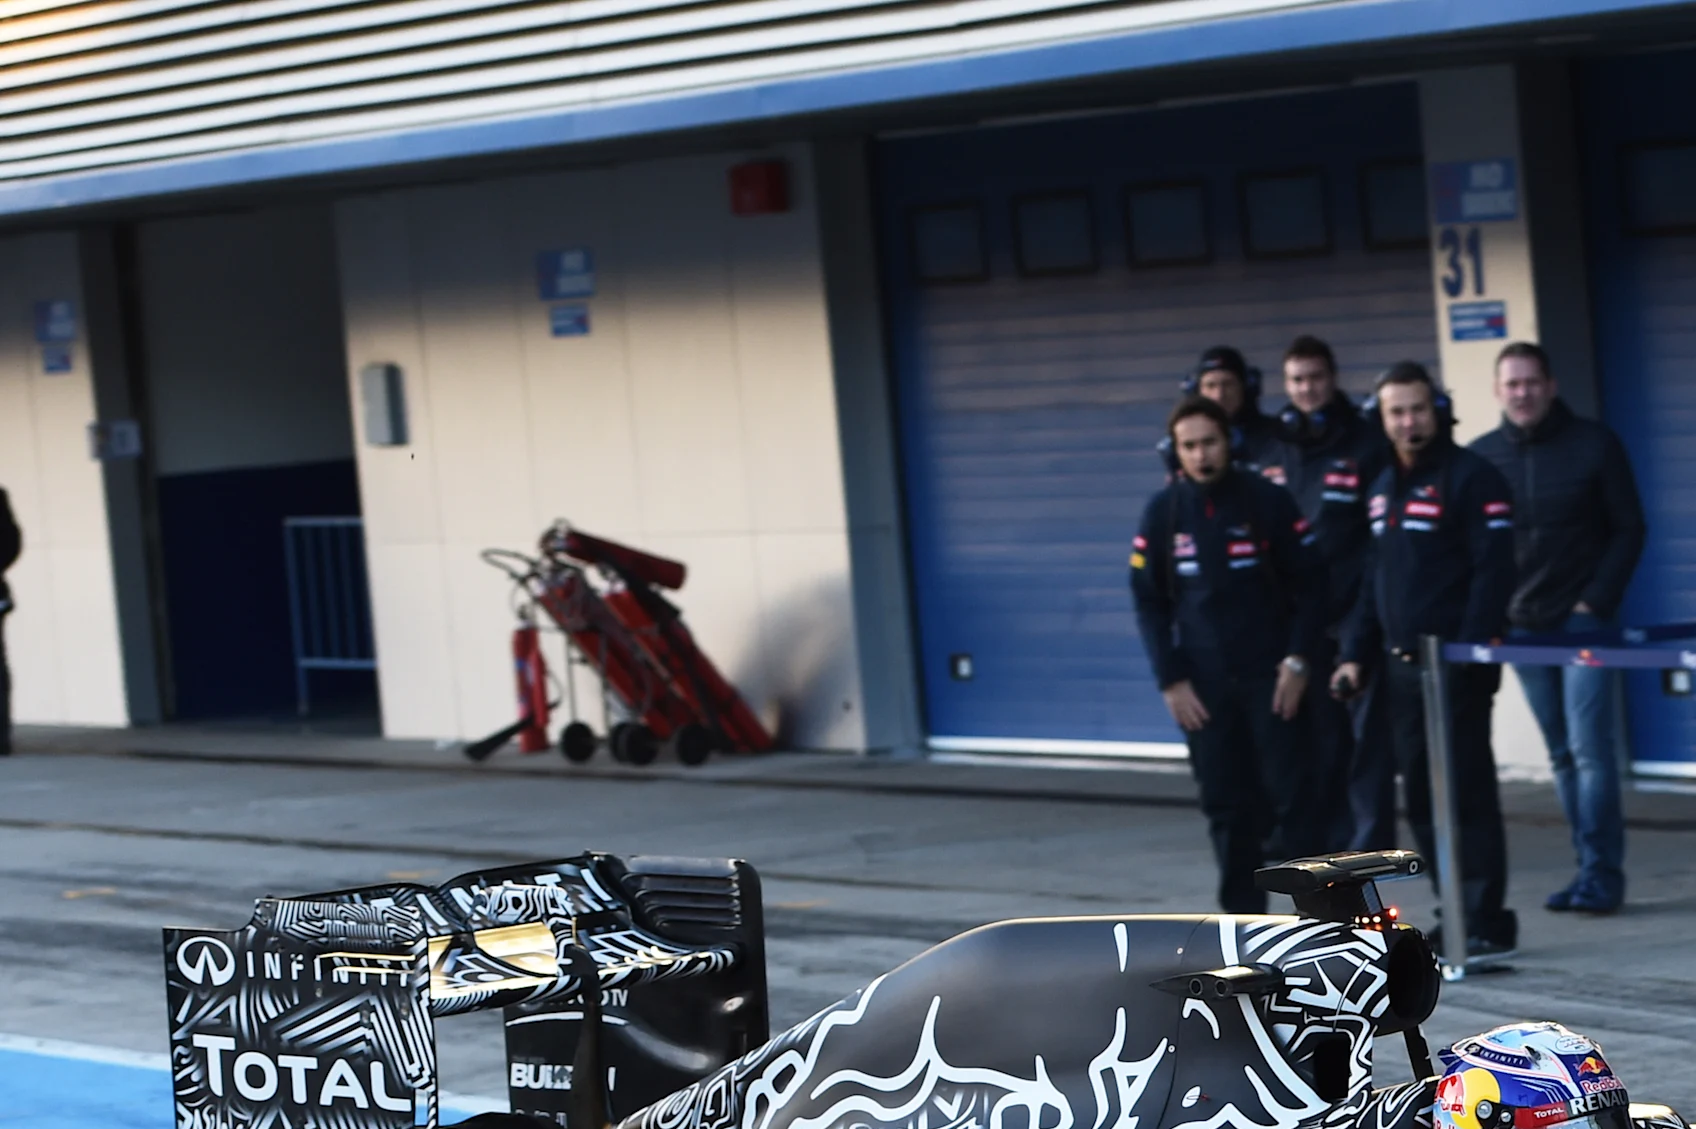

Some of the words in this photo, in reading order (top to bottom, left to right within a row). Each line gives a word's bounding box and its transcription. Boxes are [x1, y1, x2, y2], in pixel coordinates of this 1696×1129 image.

[1440, 226, 1484, 297] 31
[246, 951, 408, 987] INFINITI
[193, 1033, 412, 1112] TOTAL
[1480, 1049, 1524, 1065] INFINITI
[1534, 1107, 1565, 1119] TOTAL
[1569, 1089, 1629, 1115] RENAU
